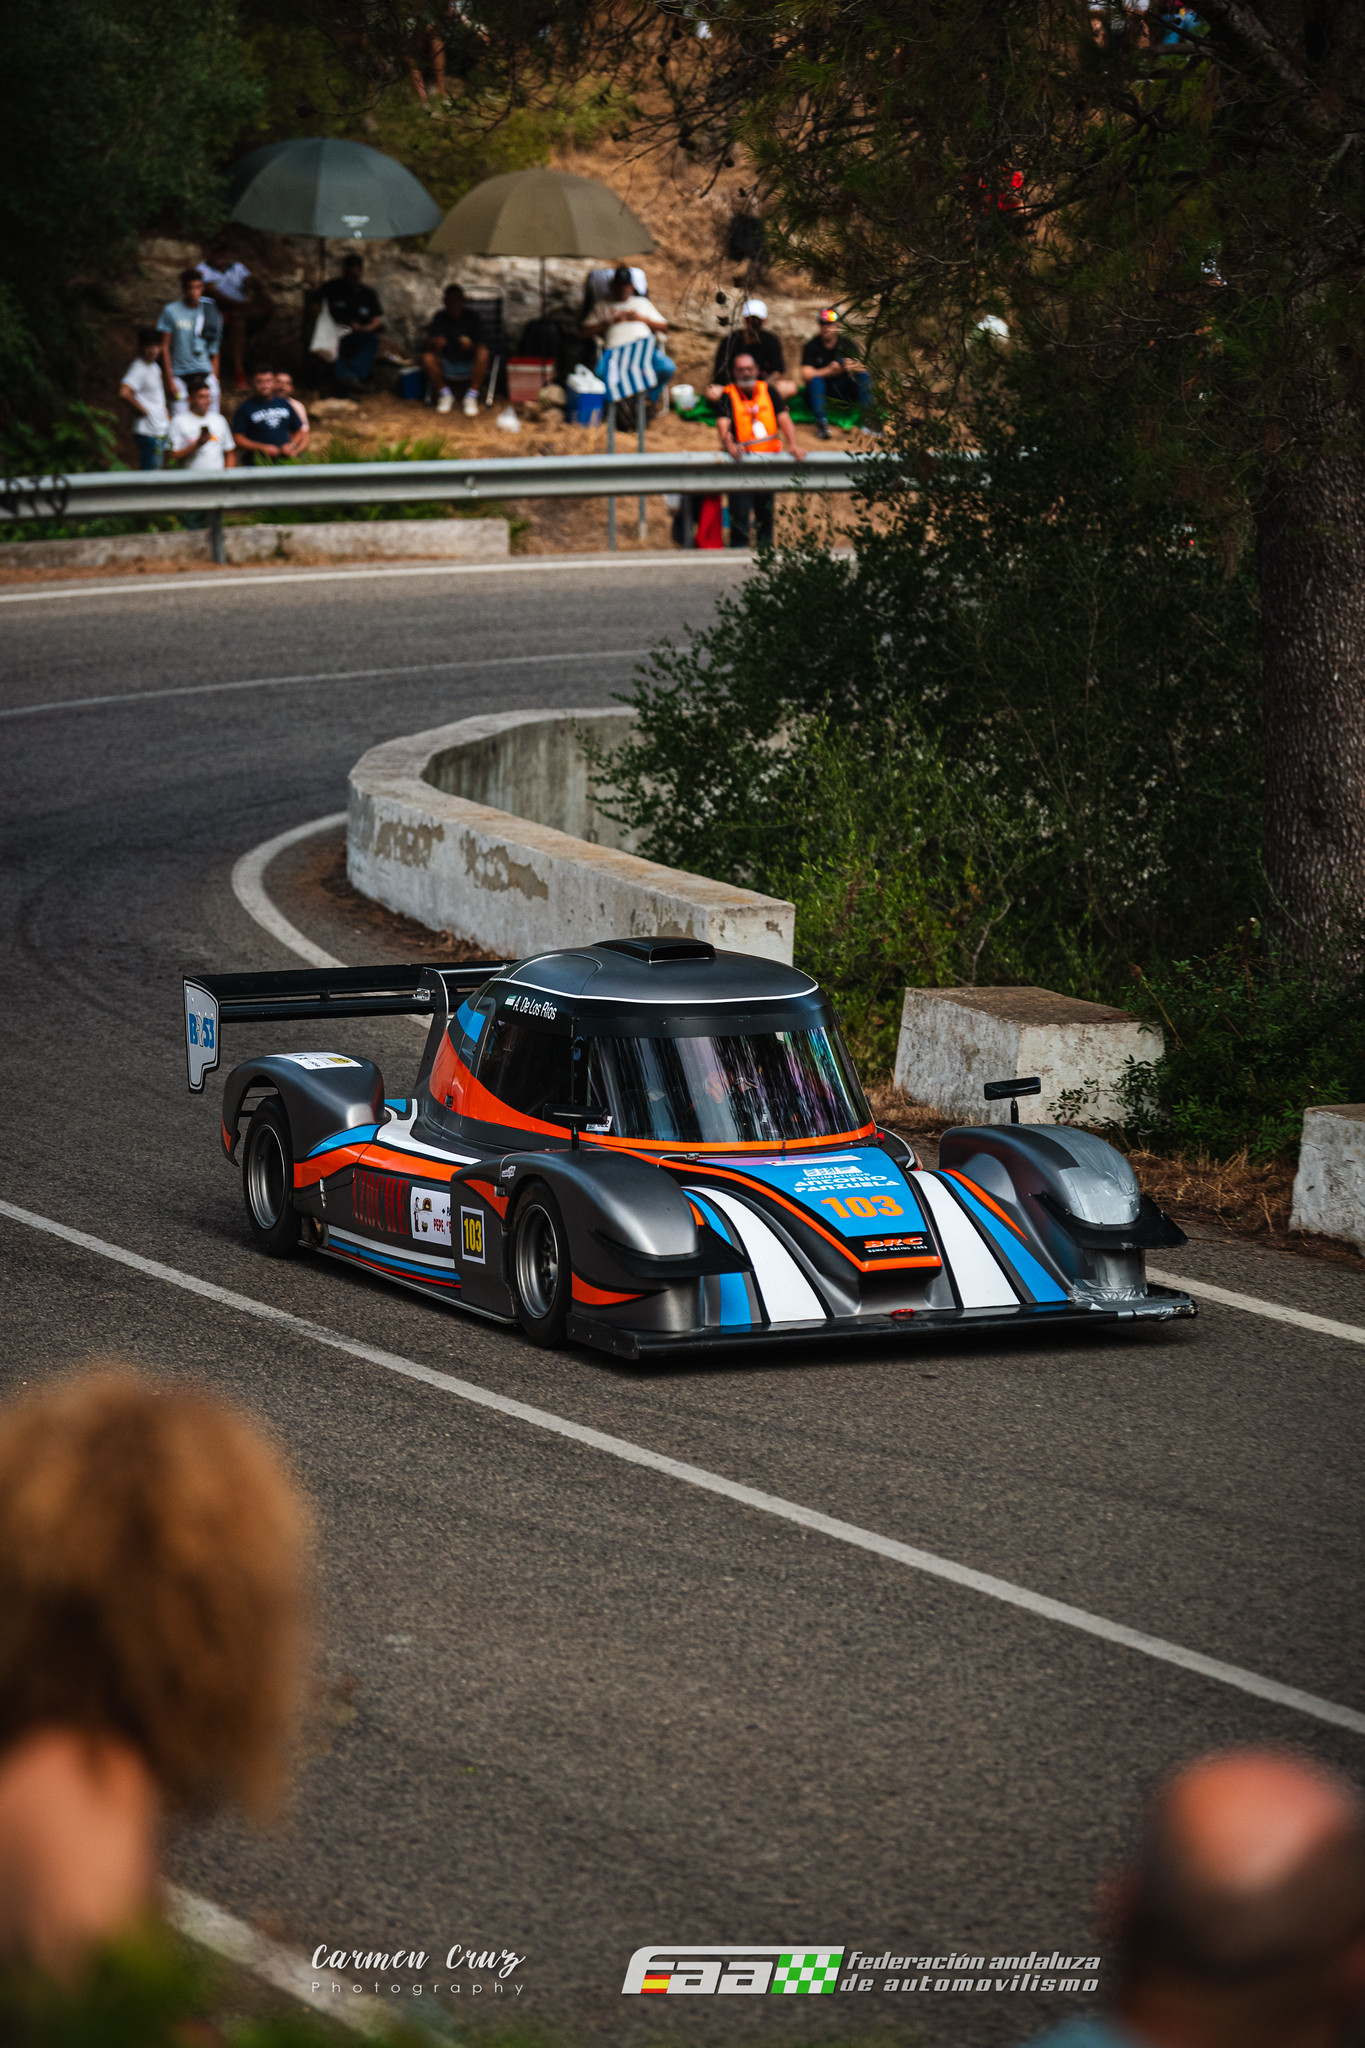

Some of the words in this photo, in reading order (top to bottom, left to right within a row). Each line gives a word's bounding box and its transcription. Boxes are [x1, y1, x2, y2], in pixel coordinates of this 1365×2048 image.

[520, 997, 530, 1013] De
[529, 999, 541, 1016] Los
[540, 1001, 558, 1020] Ríos
[820, 1195, 904, 1219] 103
[463, 1217, 483, 1253] 103
[863, 1236, 924, 1249] BRC
